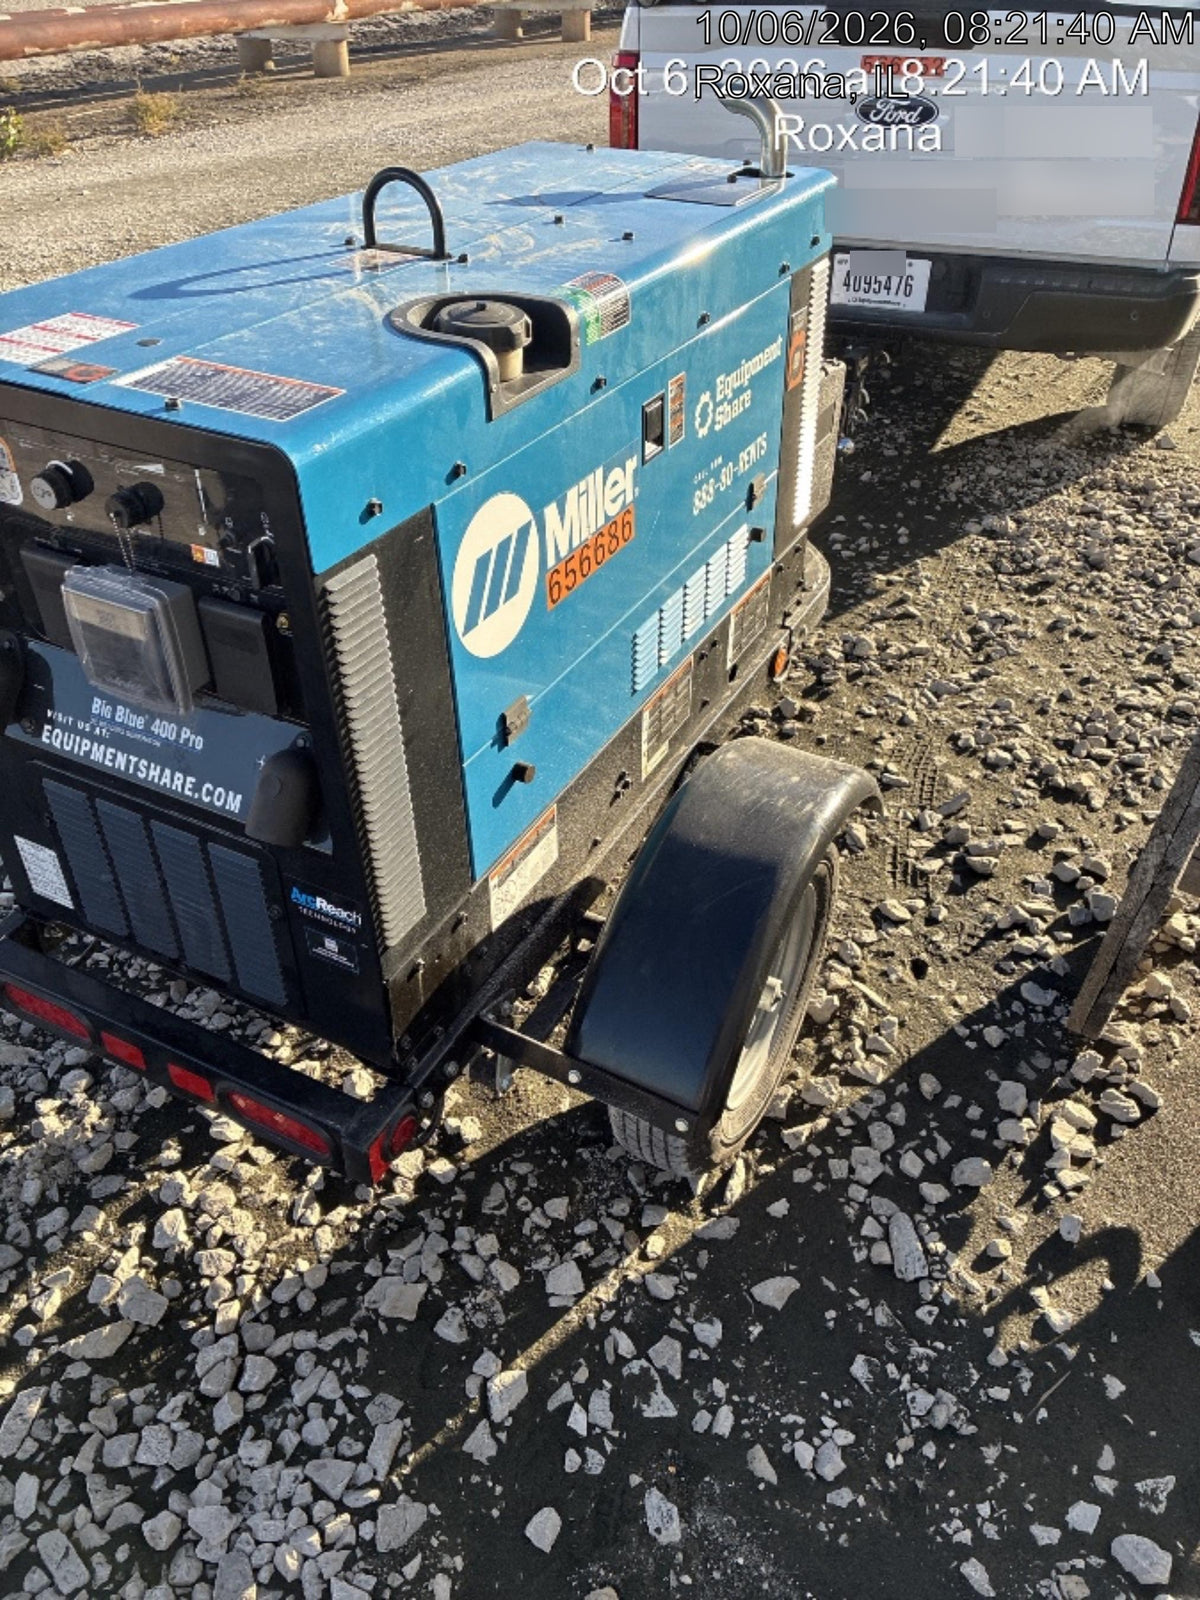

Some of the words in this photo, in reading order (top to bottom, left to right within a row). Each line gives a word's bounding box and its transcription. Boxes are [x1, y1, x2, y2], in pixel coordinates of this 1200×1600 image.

[868, 98, 924, 124] Ford
[716, 334, 784, 402] Equipment
[714, 389, 753, 431] Share
[544, 454, 638, 570] Miller
[549, 508, 632, 605] 656686
[46, 709, 74, 727] VISIT
[77, 720, 91, 733] US
[150, 718, 177, 741] 400
[179, 727, 204, 751] Pro
[41, 724, 243, 814] EQUIPMENTSHARE.COM
